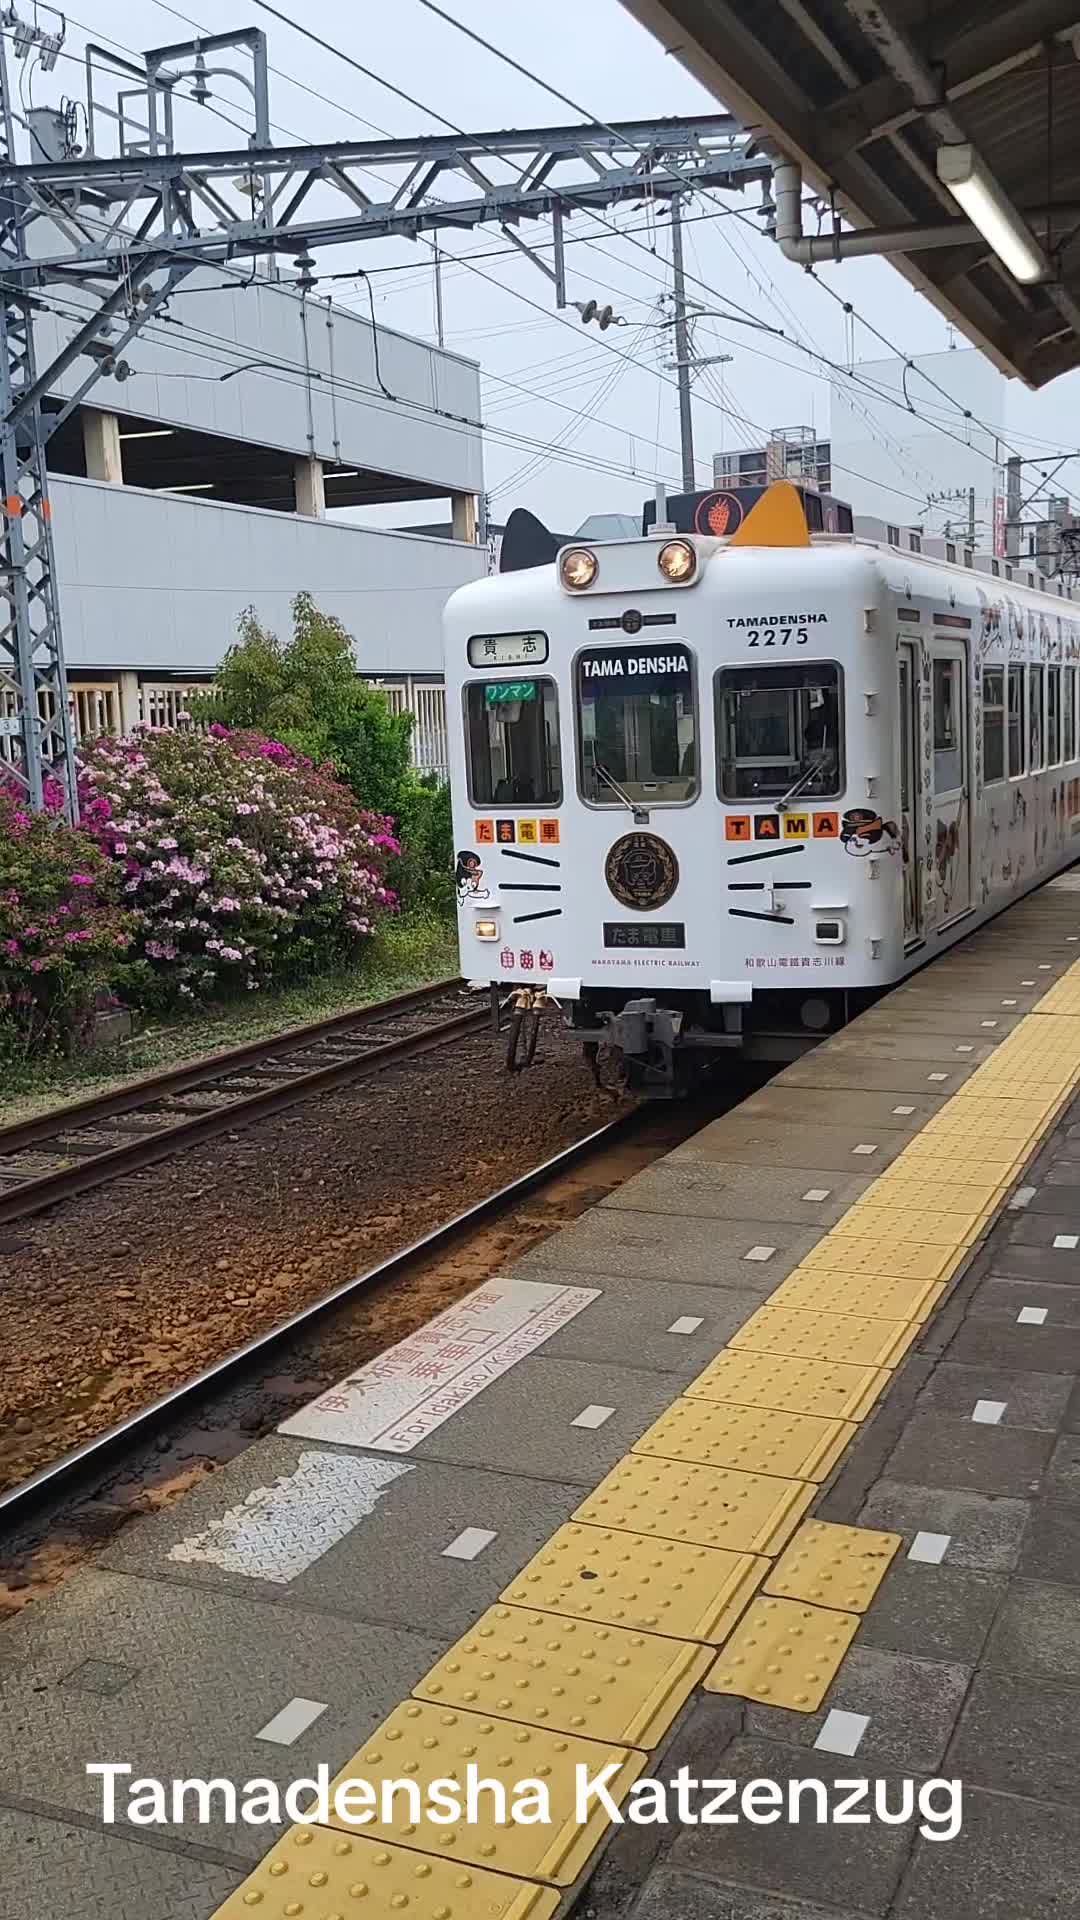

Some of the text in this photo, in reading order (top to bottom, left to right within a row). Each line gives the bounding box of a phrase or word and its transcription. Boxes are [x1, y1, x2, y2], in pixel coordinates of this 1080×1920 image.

[727, 614, 828, 628] TAMADENSHA
[483, 636, 537, 656] 貴志
[747, 628, 809, 647] 2275
[582, 655, 689, 678] TAMA DENSHA
[486, 683, 534, 700] ワンマン
[479, 822, 557, 841] たま電車
[730, 817, 834, 836] TAMA
[611, 927, 678, 945] たま電車
[633, 959, 666, 967] ELECTRIC
[408, 1328, 501, 1380] 乗車口
[390, 1418, 433, 1442] For
[526, 1292, 590, 1337] Entrance
